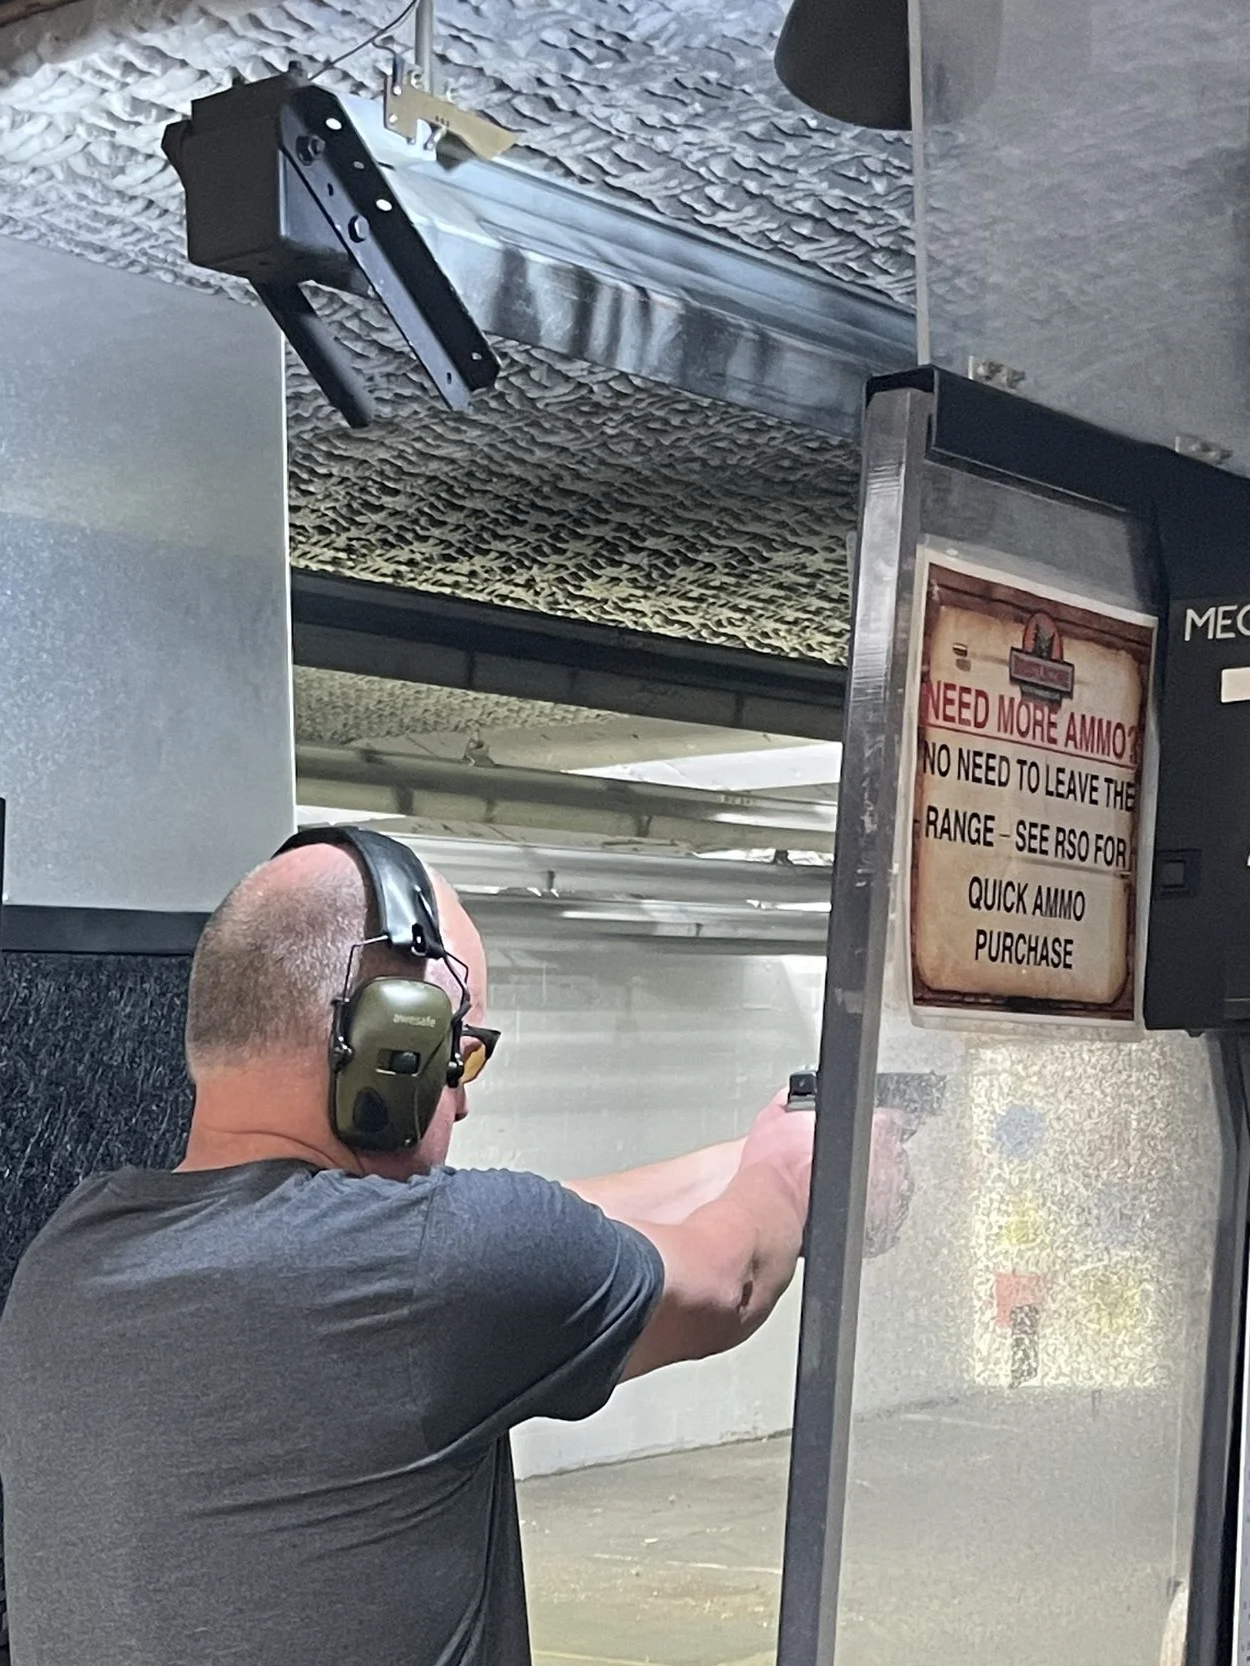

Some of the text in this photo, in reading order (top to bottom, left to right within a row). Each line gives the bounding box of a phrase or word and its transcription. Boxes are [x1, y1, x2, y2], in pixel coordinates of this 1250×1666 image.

[923, 680, 990, 730] NEED
[997, 693, 1058, 746] MORE
[921, 740, 1136, 813] NO NEED TO LEAVE THE
[925, 804, 996, 848] RANGE
[1015, 819, 1050, 856] SEE
[1054, 826, 1090, 863] RSO
[1094, 833, 1127, 869] FOR
[968, 875, 1086, 922] QUICK AMMO
[974, 928, 1074, 970] PURCHASE
